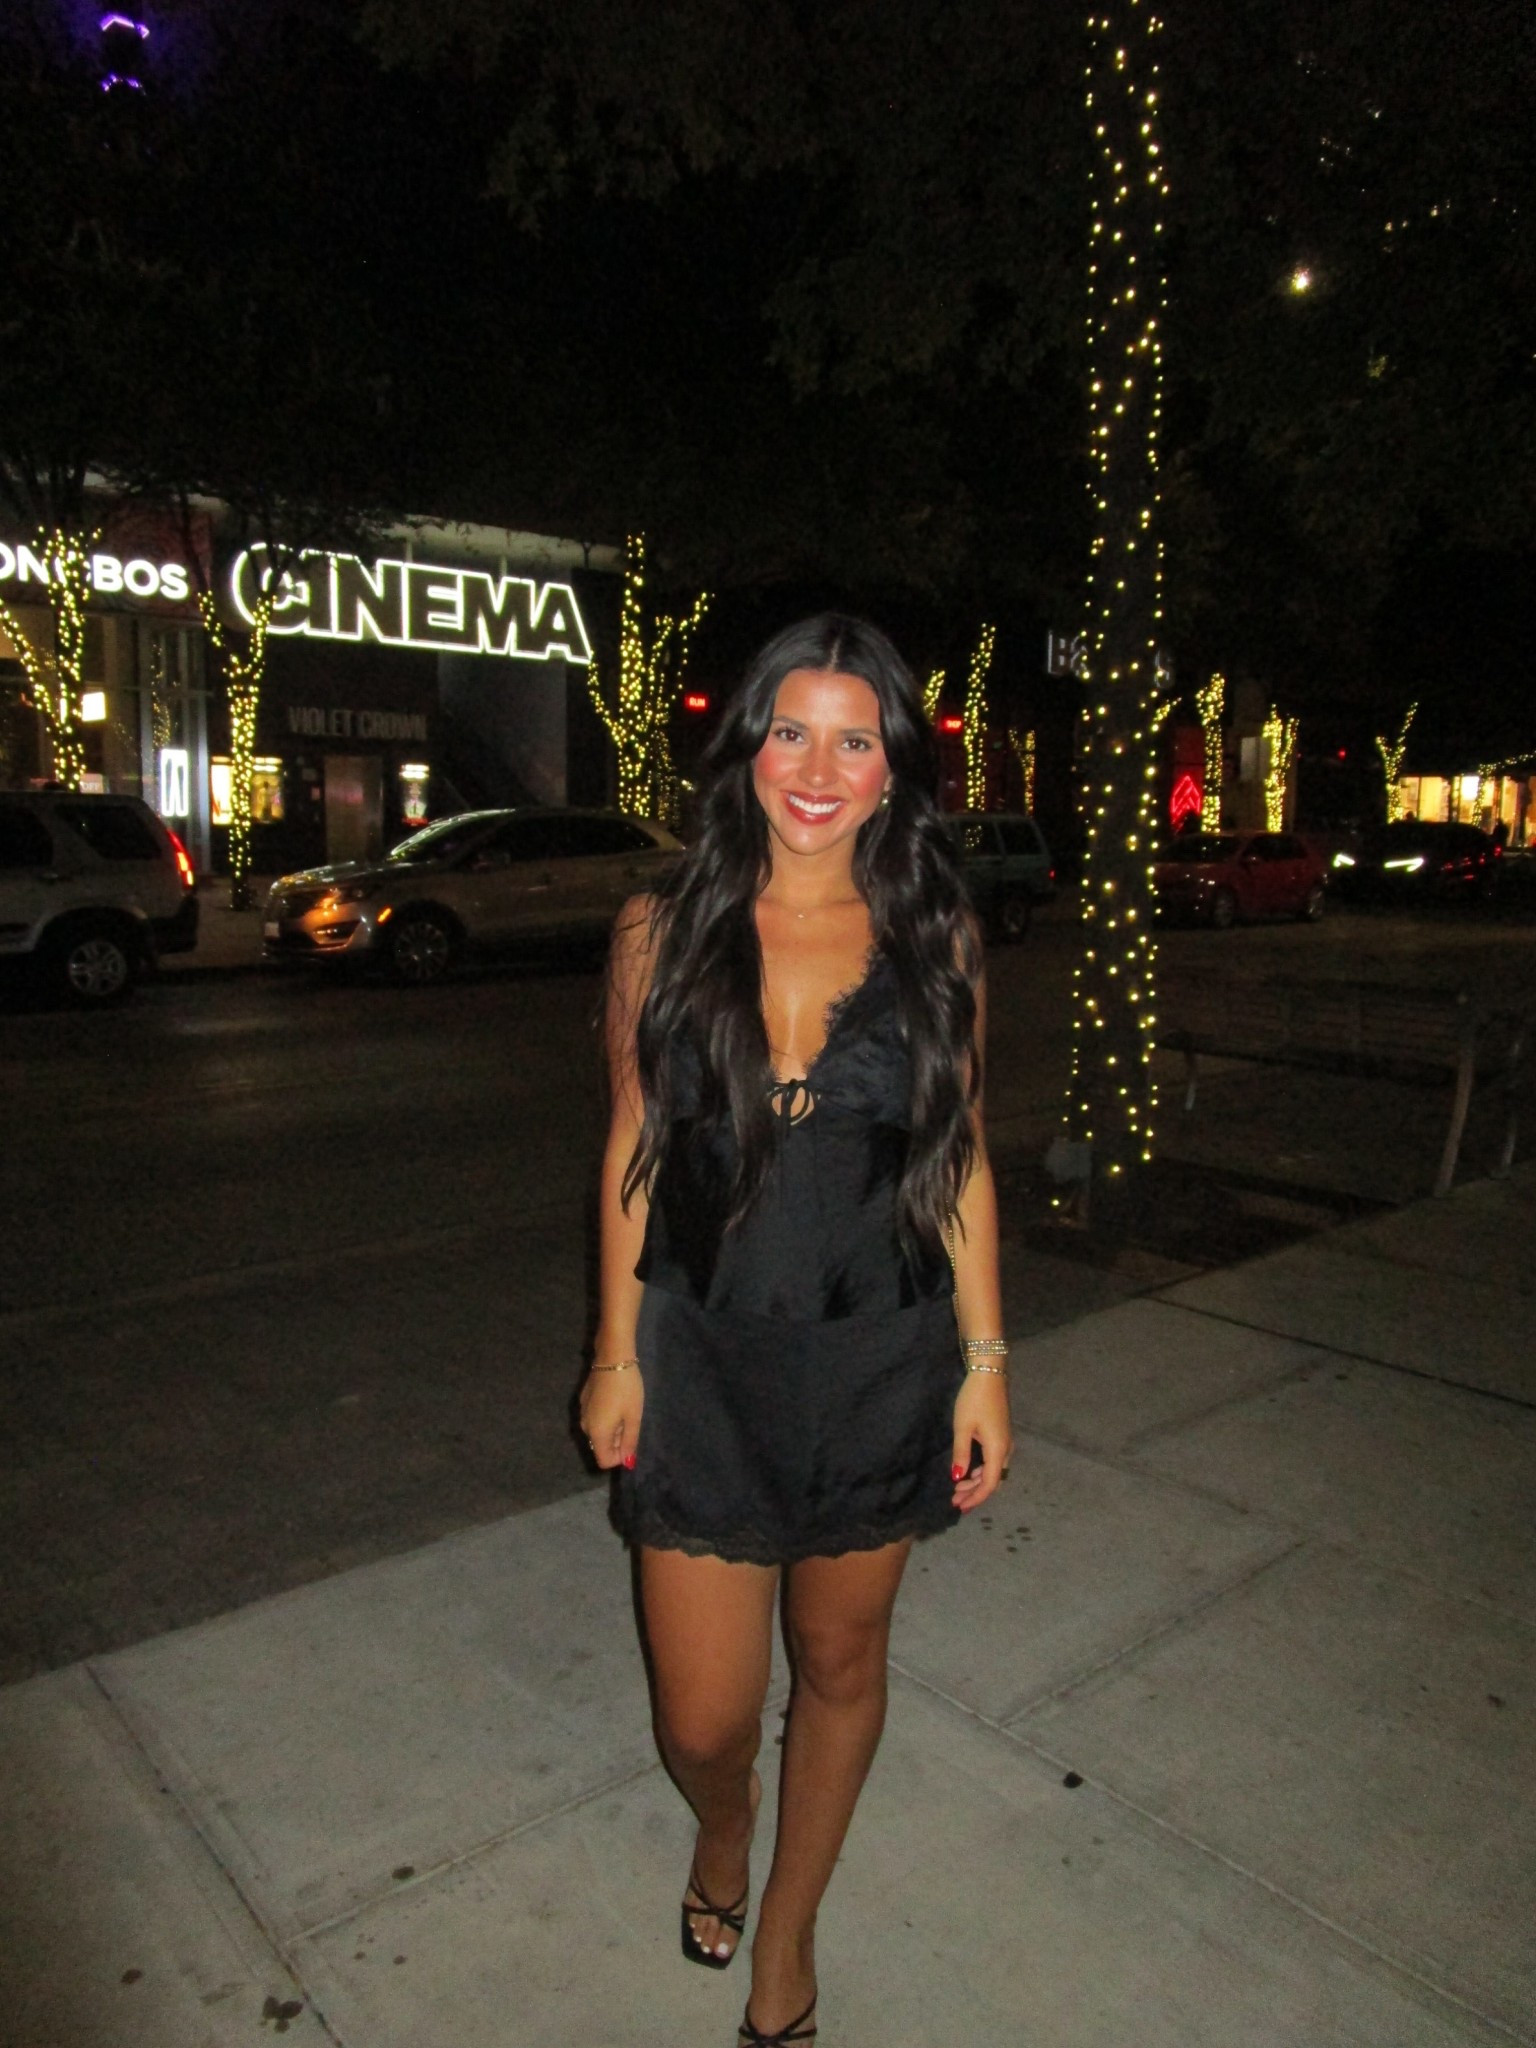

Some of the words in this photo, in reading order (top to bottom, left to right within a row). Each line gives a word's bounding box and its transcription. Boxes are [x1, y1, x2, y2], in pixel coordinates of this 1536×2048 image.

[231, 541, 593, 665] CINEMA
[288, 706, 353, 737] VIOLET
[358, 710, 428, 741] CROWN
